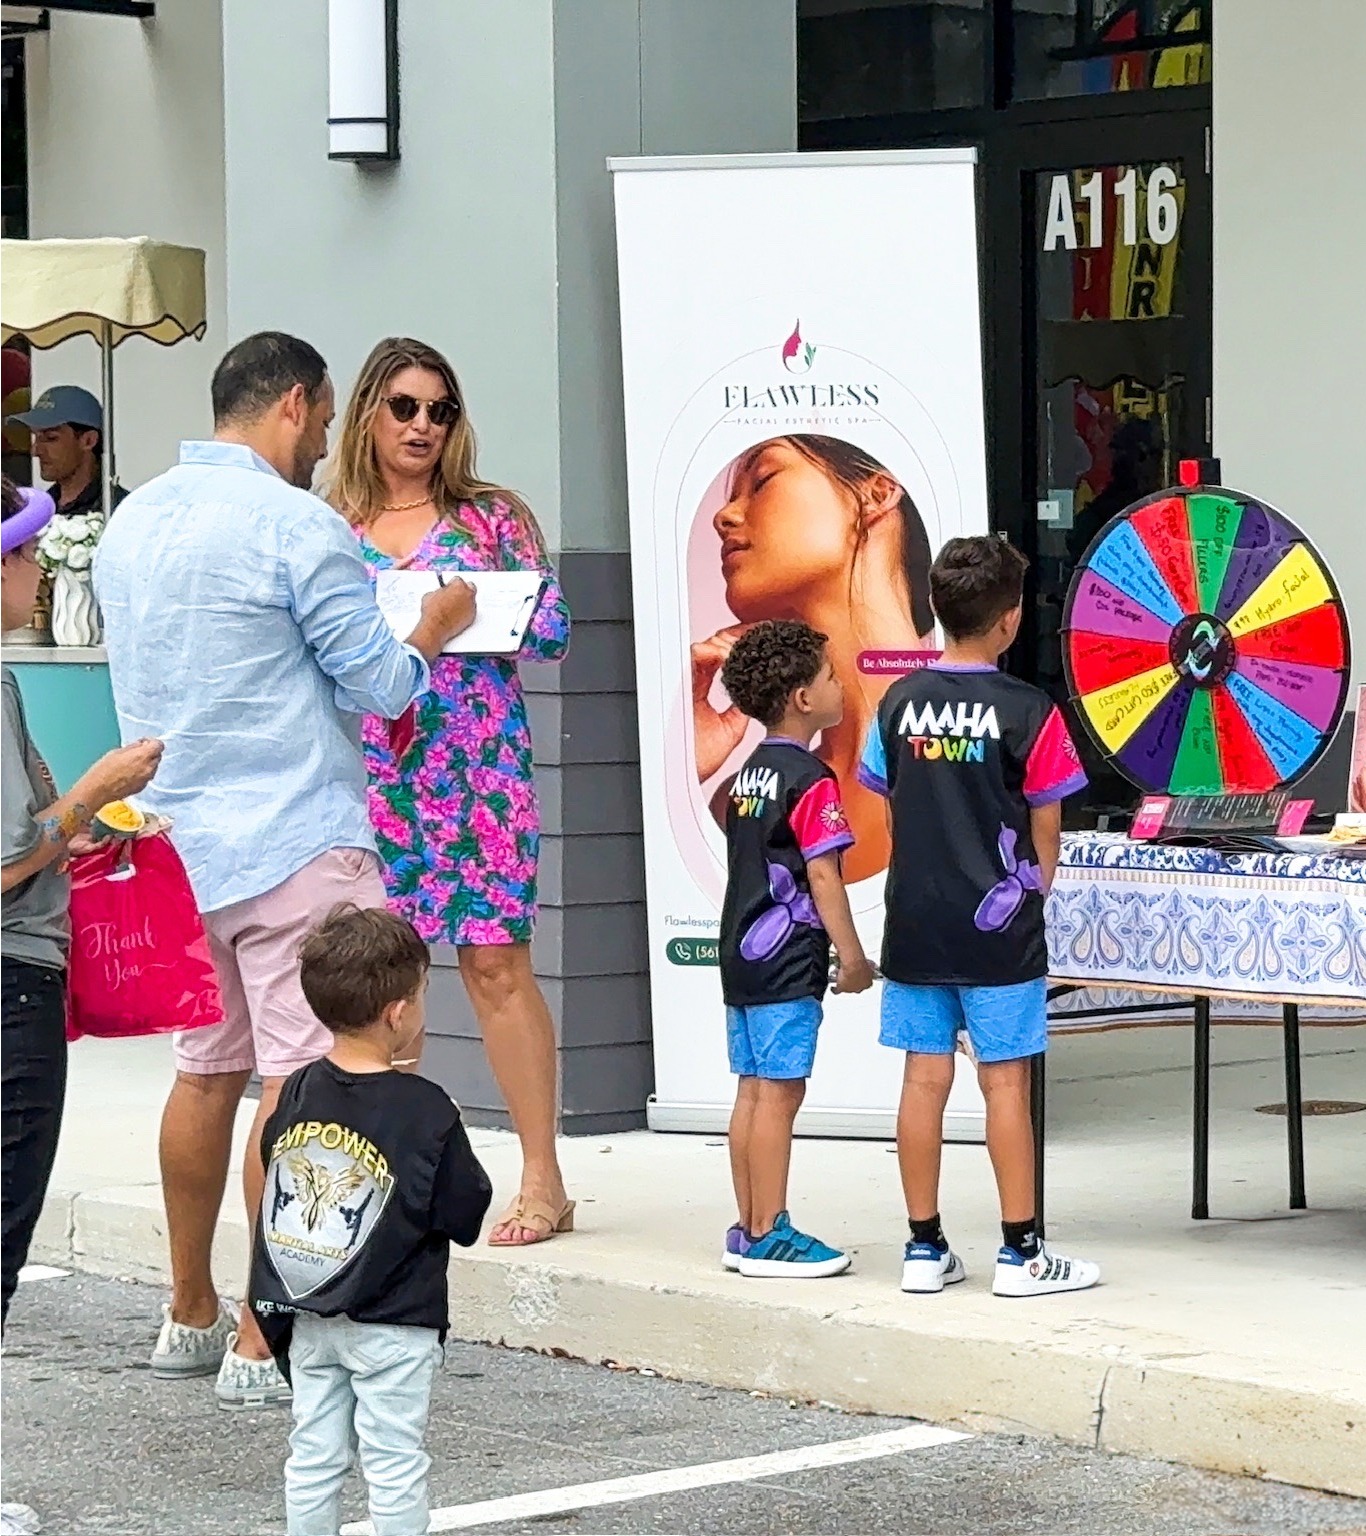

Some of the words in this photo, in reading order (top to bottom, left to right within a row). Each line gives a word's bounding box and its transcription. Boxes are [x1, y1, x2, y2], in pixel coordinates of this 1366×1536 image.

[1043, 167, 1178, 252] A116
[725, 384, 879, 408] FLAWLESS
[863, 658, 874, 668] Be
[907, 736, 985, 763] TOWN
[81, 916, 156, 959] Thank
[696, 945, 719, 960] (561
[104, 959, 170, 990] You
[272, 1121, 390, 1188] EMPOWER
[280, 1248, 326, 1266] ACADEMY
